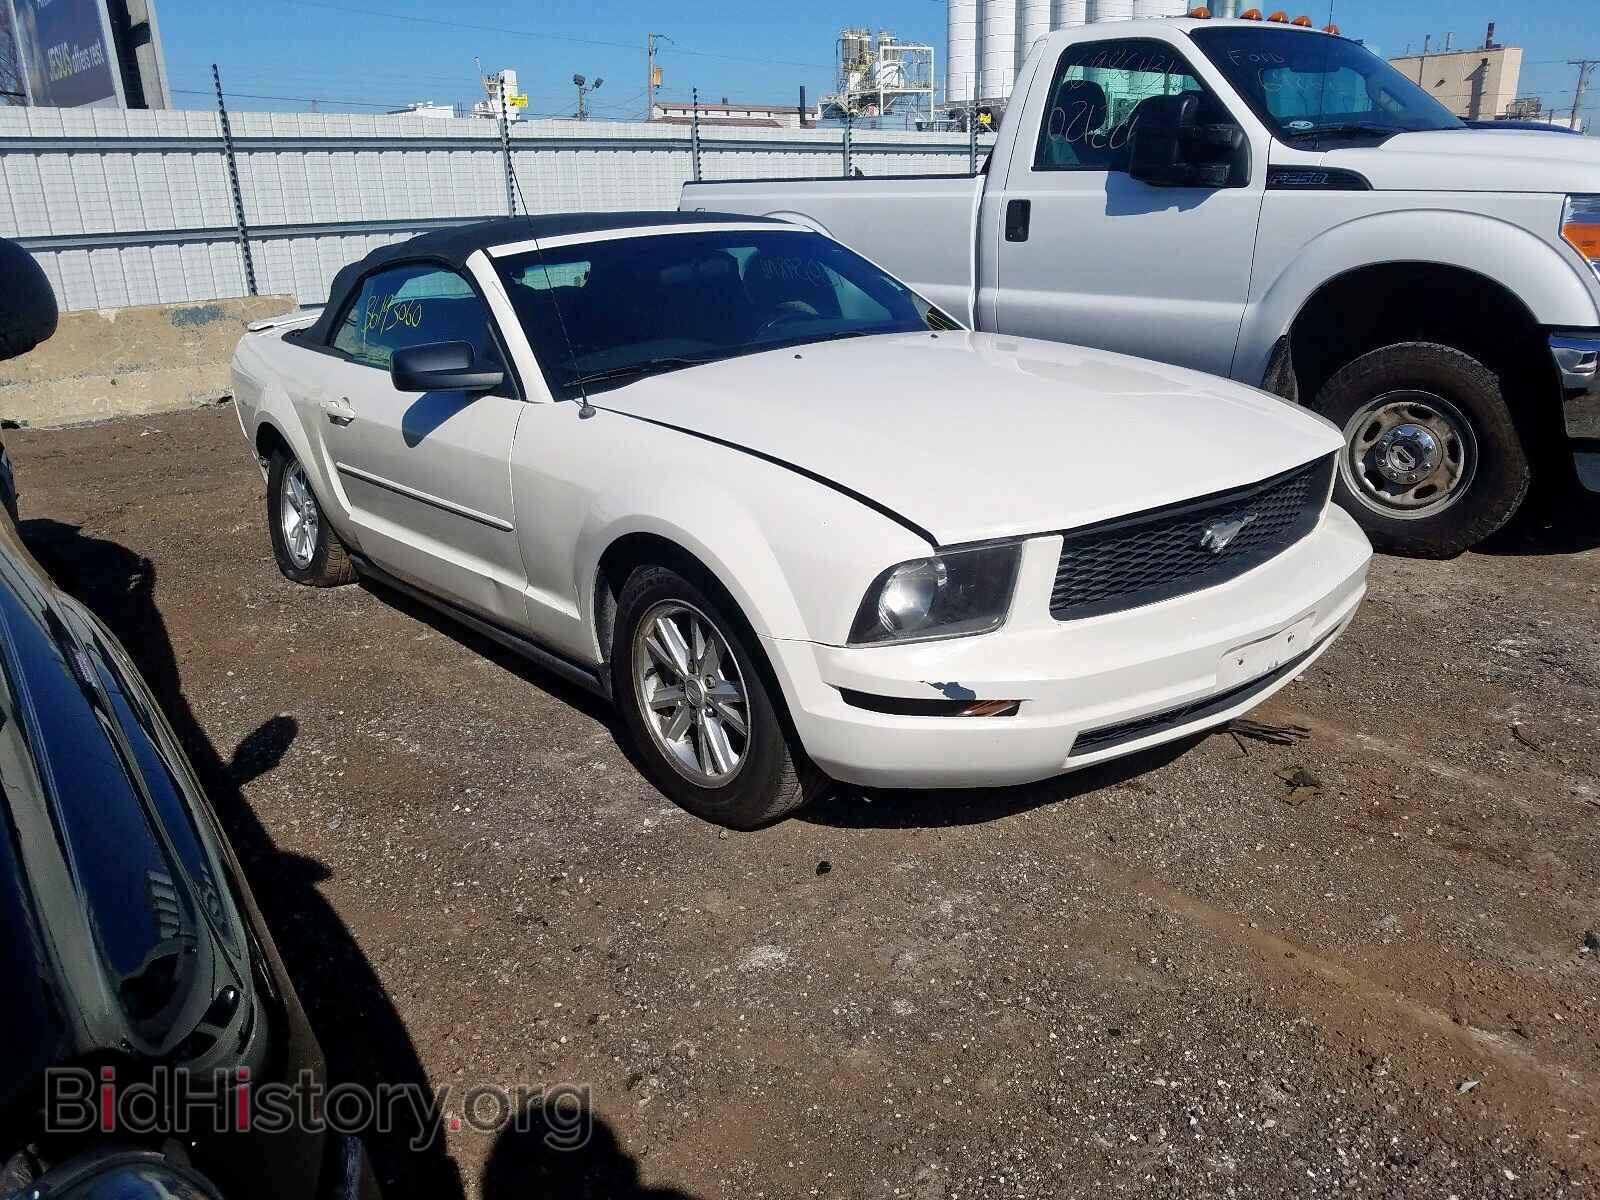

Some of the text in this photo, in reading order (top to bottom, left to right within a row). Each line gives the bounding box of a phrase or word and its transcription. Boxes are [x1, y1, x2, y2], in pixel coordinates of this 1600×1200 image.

[48, 38, 105, 80] JESUS offers rest
